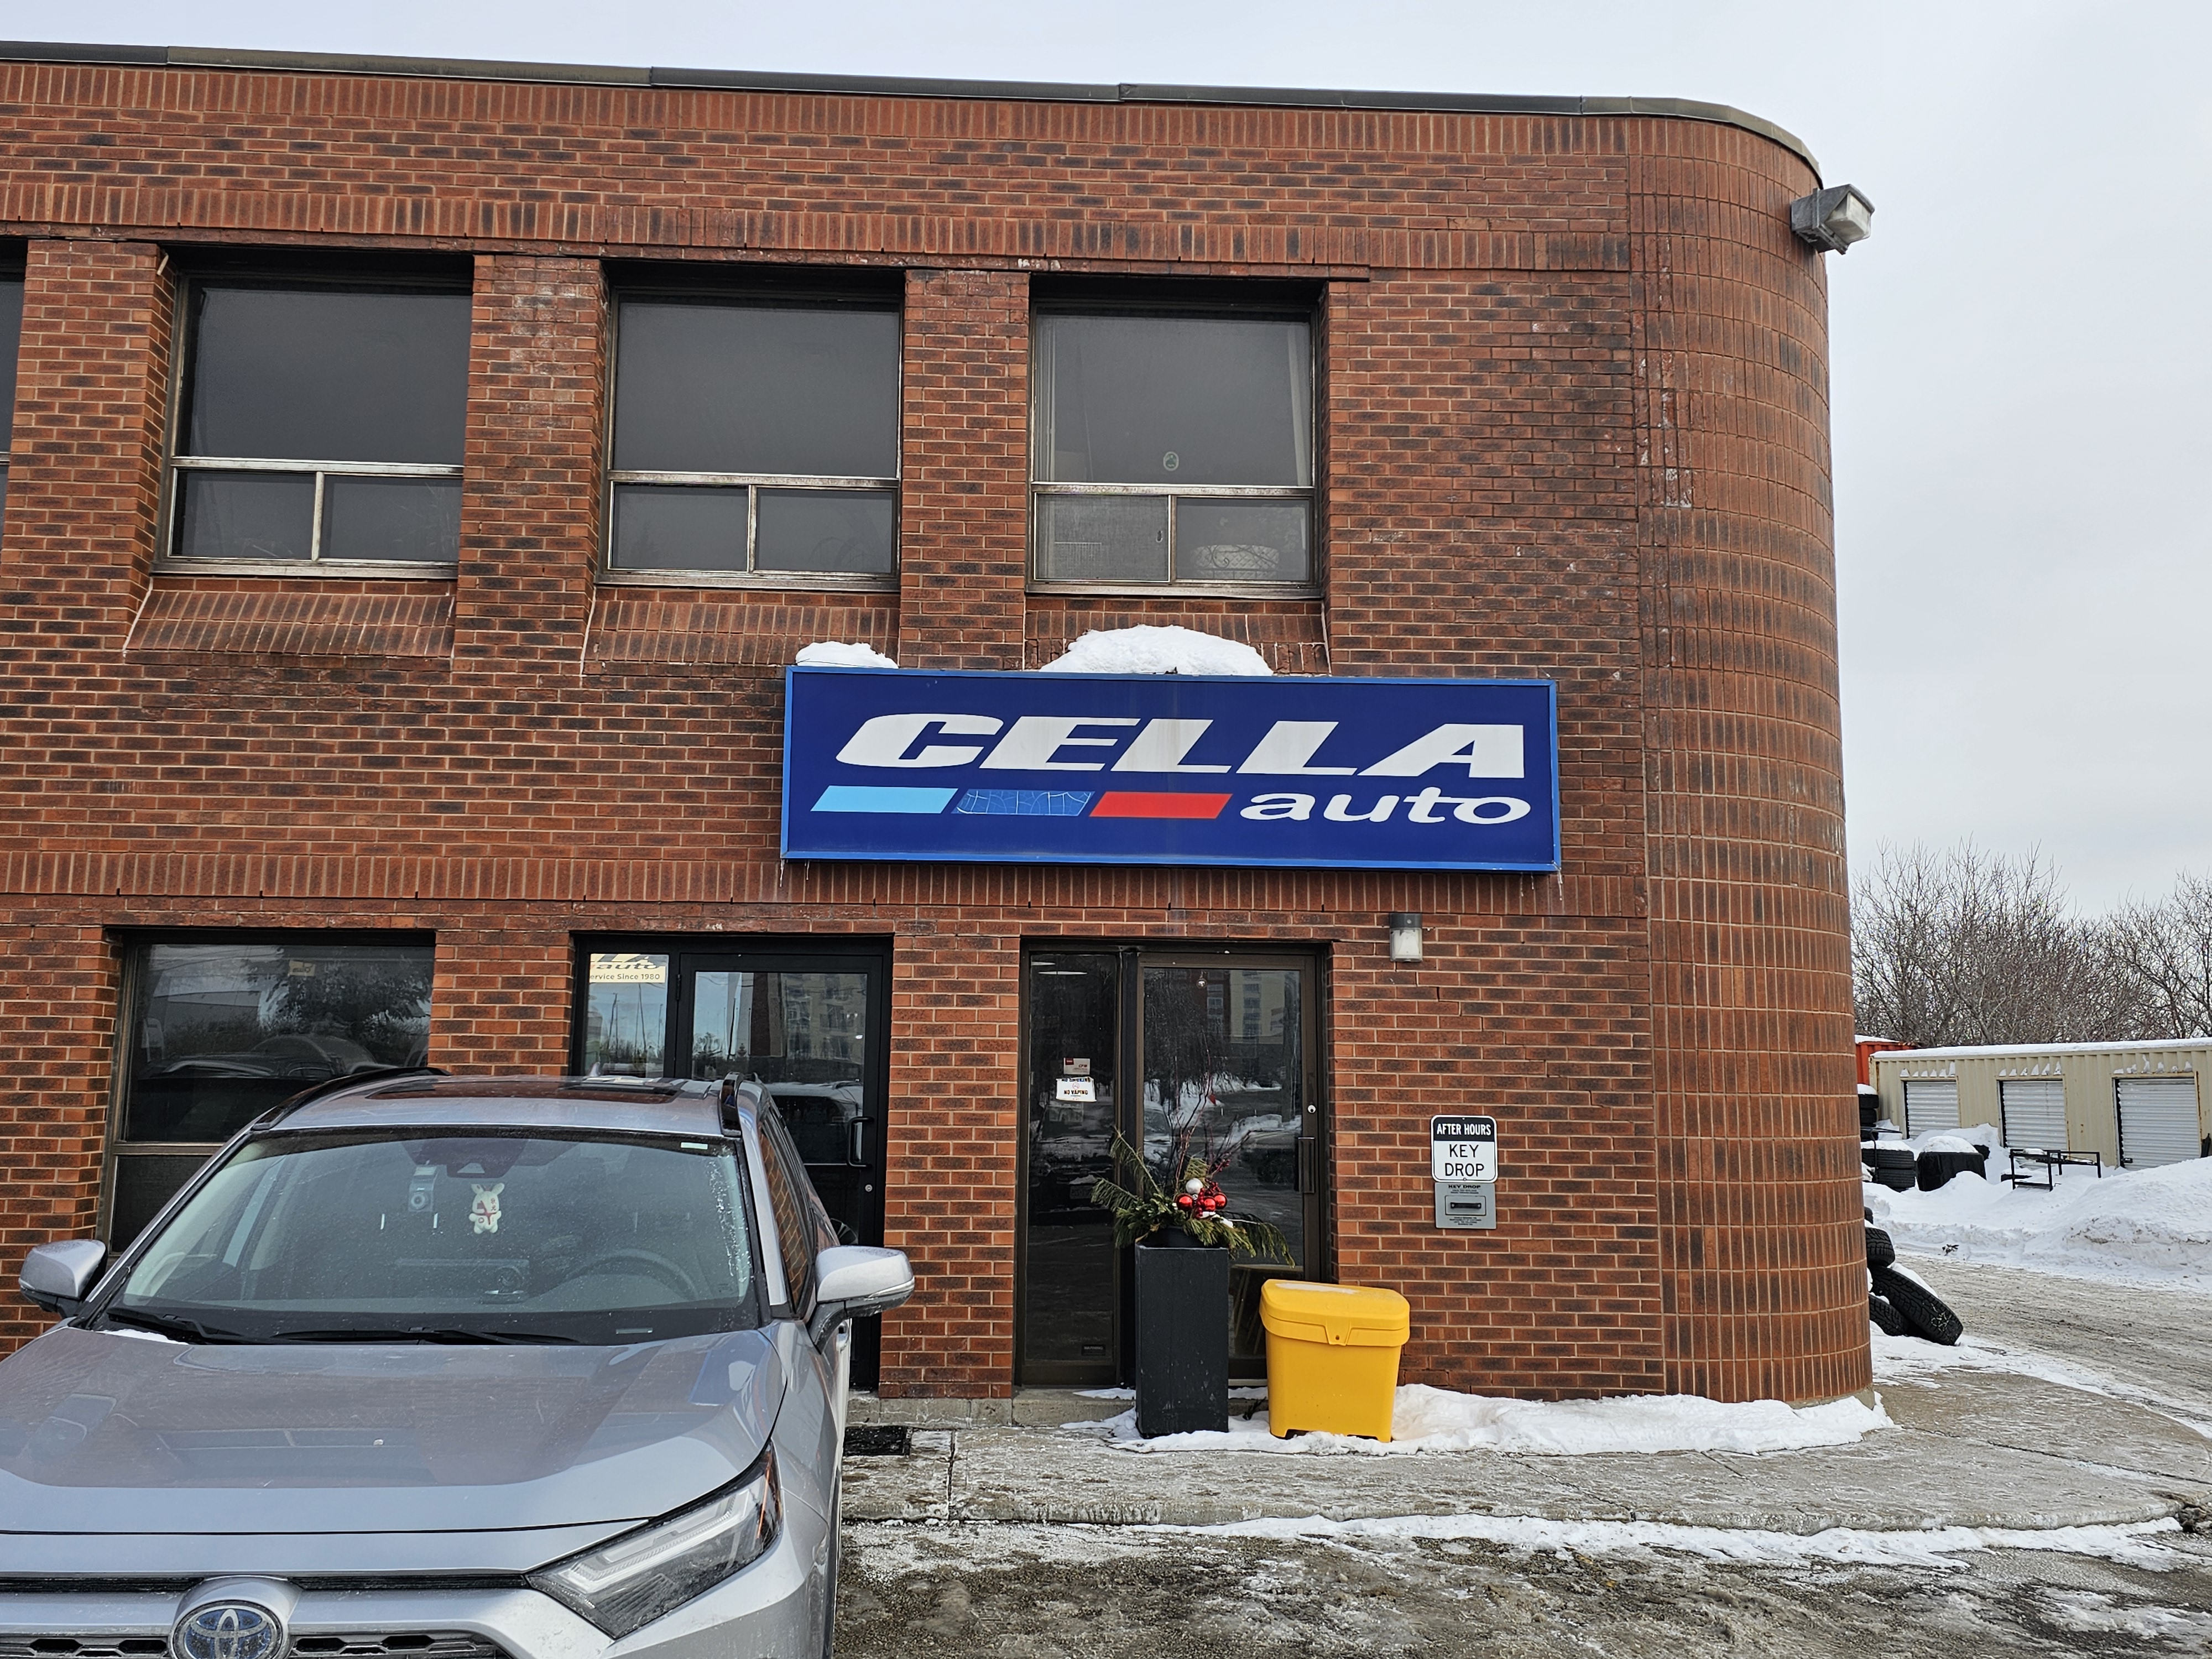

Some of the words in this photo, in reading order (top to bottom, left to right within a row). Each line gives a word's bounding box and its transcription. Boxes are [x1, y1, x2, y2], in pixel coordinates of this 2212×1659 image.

[836, 712, 1525, 779] CELLA
[1239, 786, 1531, 824] auto
[1437, 1123, 1462, 1135] AFTER
[1464, 1124, 1491, 1136] HOURS
[1449, 1144, 1479, 1157] KEY
[1444, 1162, 1484, 1177] DROP
